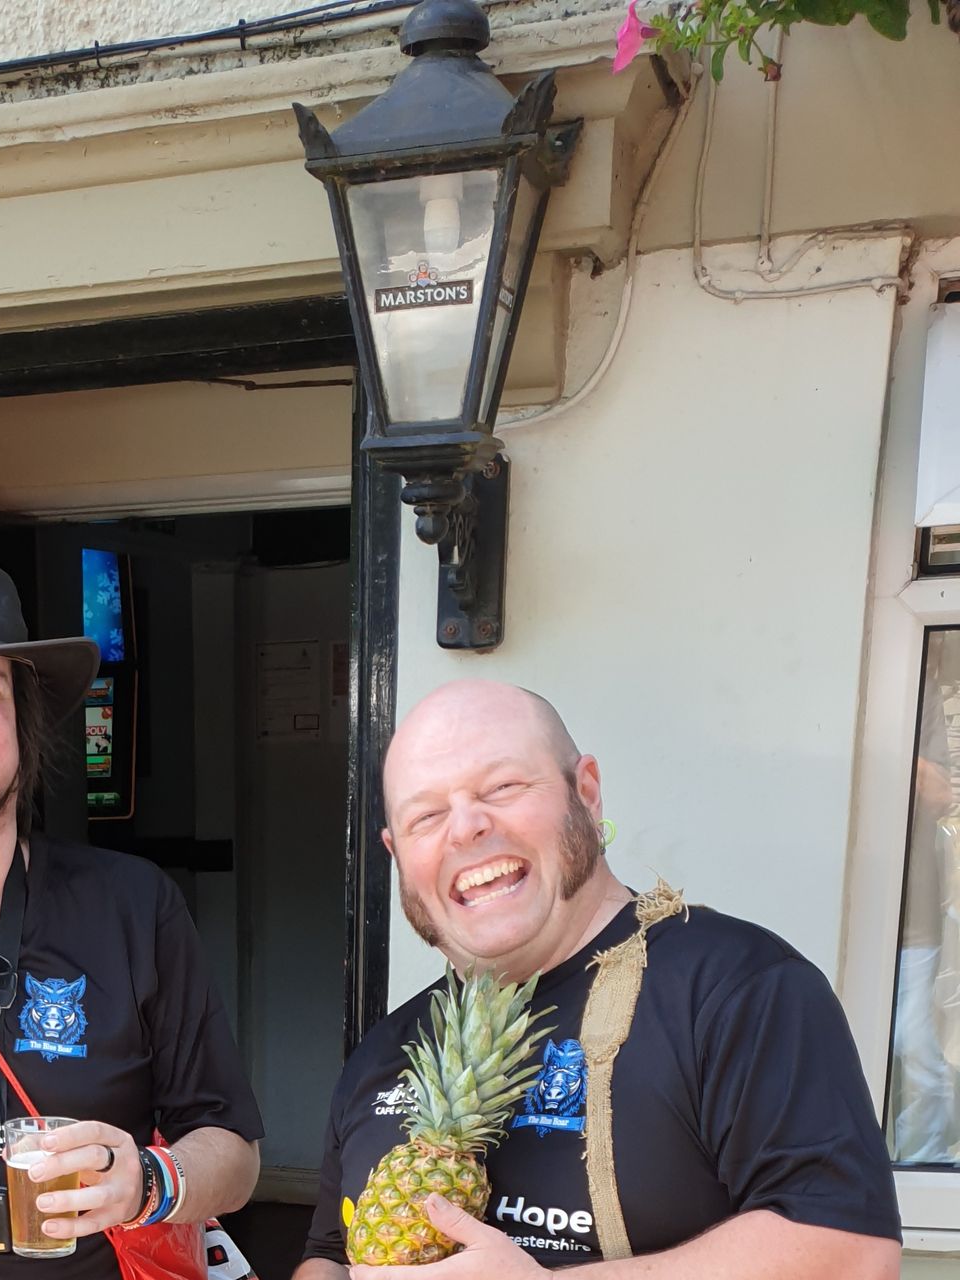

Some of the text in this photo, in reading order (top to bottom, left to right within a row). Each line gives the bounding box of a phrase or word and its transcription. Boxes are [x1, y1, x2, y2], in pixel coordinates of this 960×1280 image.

[381, 285, 468, 307] MARSTON'S
[85, 726, 108, 737] POLY
[496, 1195, 593, 1235] Hope
